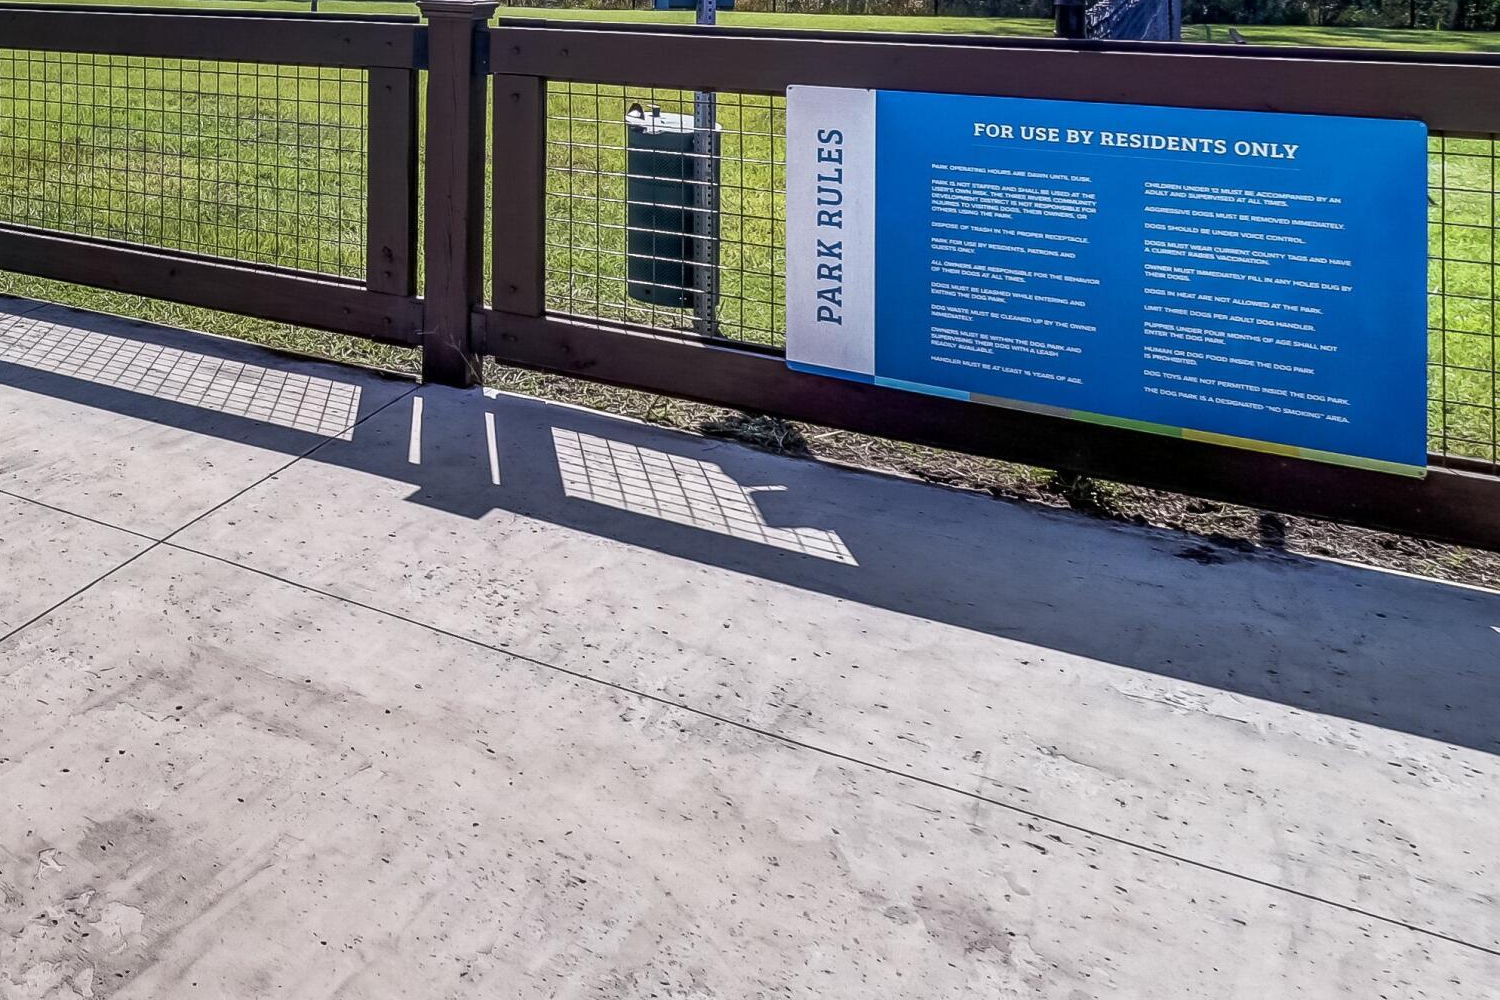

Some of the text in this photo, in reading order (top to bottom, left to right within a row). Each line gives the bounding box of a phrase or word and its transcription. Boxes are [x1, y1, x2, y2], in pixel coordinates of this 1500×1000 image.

[973, 122, 1300, 159] FOR USE BY RESIDENTS ONLY
[950, 165, 986, 174] OPERATING
[987, 168, 1011, 176] HOURS
[1145, 182, 1182, 191] CHILDREN
[1183, 185, 1210, 193] UNDER
[1220, 188, 1243, 196] MUST
[1256, 191, 1315, 201] ACCOMPANIED
[1145, 189, 1168, 197] ADULT
[1170, 191, 1187, 199] AND
[1188, 193, 1235, 203] SUPERVISED
[816, 128, 843, 325] PARK RULES
[1145, 206, 1190, 216] AGGRESSIVE
[1192, 210, 1214, 218] DOGS
[1251, 216, 1290, 225] REMOVED
[932, 222, 958, 230] DISPOSE
[971, 226, 993, 234] TRASH
[1017, 230, 1044, 239] PROPER
[1145, 223, 1166, 231] DOGS
[1167, 225, 1199, 234] SHOULD
[1212, 230, 1239, 238] UNDER
[1240, 232, 1264, 240] VOICE
[1144, 240, 1352, 266] DOGS MUST WEAR CURRENT COUNTY TAGS AND HAVE
[1145, 264, 1172, 273] OWNER
[1173, 267, 1195, 275] MUST
[1196, 270, 1246, 281] IMMEDIATELY
[1293, 280, 1320, 288] HOLES
[931, 282, 950, 290] DOGS
[980, 288, 1011, 298] LEASHED
[1012, 292, 1033, 300] WHILE
[1034, 295, 1069, 305] ENTERING
[1070, 299, 1085, 307] AND
[1144, 288, 1166, 296] DOGS
[1176, 292, 1196, 300] HEAT
[1198, 294, 1213, 302] ARE
[1214, 296, 1230, 304] NOT
[1232, 298, 1270, 308] ALLOWED
[1283, 304, 1298, 312] THE
[931, 304, 946, 312] DOG
[947, 306, 969, 315] WASTE
[970, 309, 989, 317] MUST
[1000, 313, 1032, 323] CLEANED
[1070, 322, 1096, 332] OWNER
[1144, 305, 1162, 313] LIMIT
[1165, 308, 1188, 316] THREE
[1190, 311, 1212, 319] DOGS
[1229, 316, 1254, 324] ADULT
[1256, 319, 1275, 327] DOG
[1144, 329, 1168, 338] ENTER
[1170, 332, 1184, 340] THE
[1185, 334, 1203, 342] DOG
[1176, 326, 1203, 335] UNDER
[1204, 329, 1225, 338] FOUR
[1227, 332, 1261, 342] MONTHS
[1276, 338, 1292, 346] AGE
[1293, 340, 1317, 349] SHALL
[1320, 344, 1337, 352] NOT
[931, 356, 961, 366] HANDLER
[962, 360, 980, 369] MUST
[1001, 366, 1022, 375] LEAST
[1033, 371, 1055, 380] YEARS
[1187, 352, 1204, 360] DOG
[1206, 354, 1228, 363] FOOD
[1229, 357, 1255, 366] INSIDE
[1257, 361, 1272, 369] THE
[1273, 363, 1292, 371] DOG
[1293, 366, 1315, 374] PARK
[1144, 370, 1161, 378] DOG
[1163, 373, 1182, 381] TOYS
[1183, 375, 1198, 383] ARE
[1199, 378, 1215, 386] NOT
[1217, 380, 1260, 392] PERMITTED
[1262, 387, 1287, 396] INSIDE
[1290, 391, 1305, 399] THE
[1307, 394, 1326, 402] DOG
[1160, 389, 1177, 397] DOG
[1178, 392, 1198, 400] PARK
[1215, 397, 1264, 410] DESIGNATED
